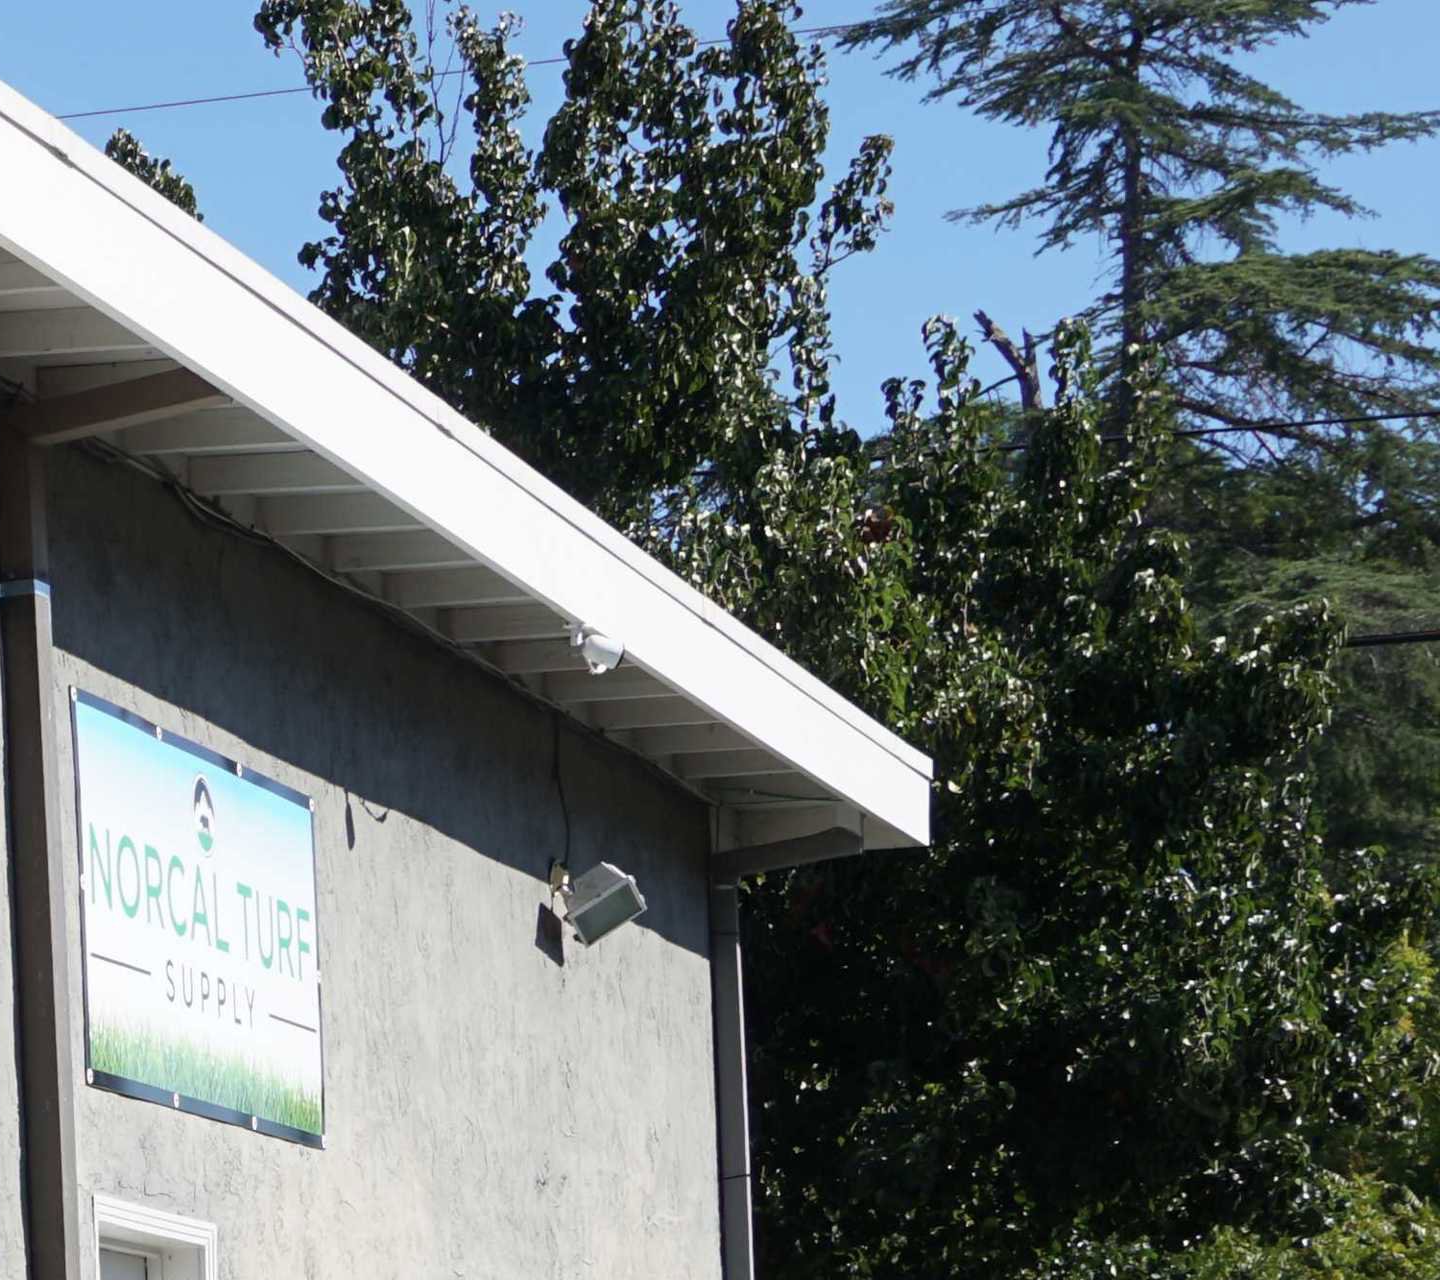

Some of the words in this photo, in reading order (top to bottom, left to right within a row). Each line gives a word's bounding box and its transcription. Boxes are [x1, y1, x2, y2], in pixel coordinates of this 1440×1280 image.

[89, 822, 229, 954] NORCAL
[236, 881, 311, 982] TURF
[165, 959, 256, 1029] SUPPLY
